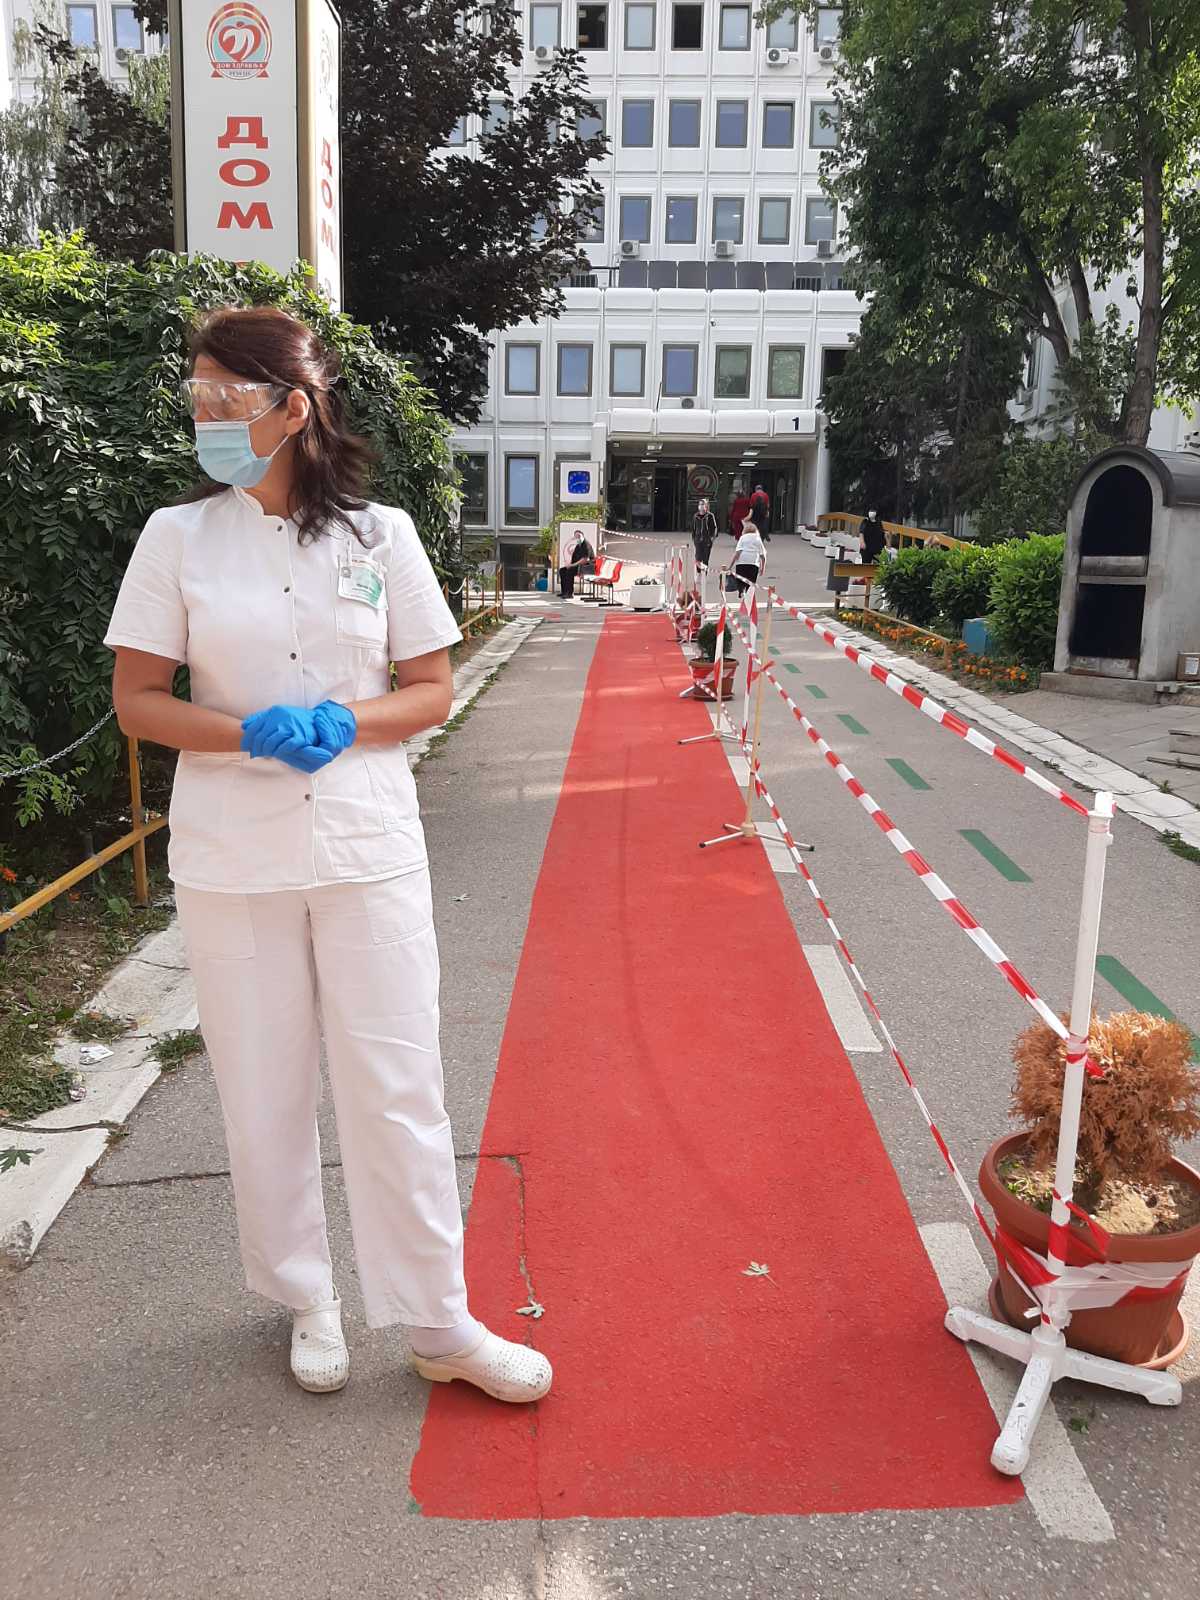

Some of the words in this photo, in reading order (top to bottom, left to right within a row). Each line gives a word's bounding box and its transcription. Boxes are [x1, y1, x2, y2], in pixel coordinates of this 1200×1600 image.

[217, 116, 273, 229] ДОМ
[320, 137, 335, 254] ДОМ
[792, 417, 800, 431] 1
